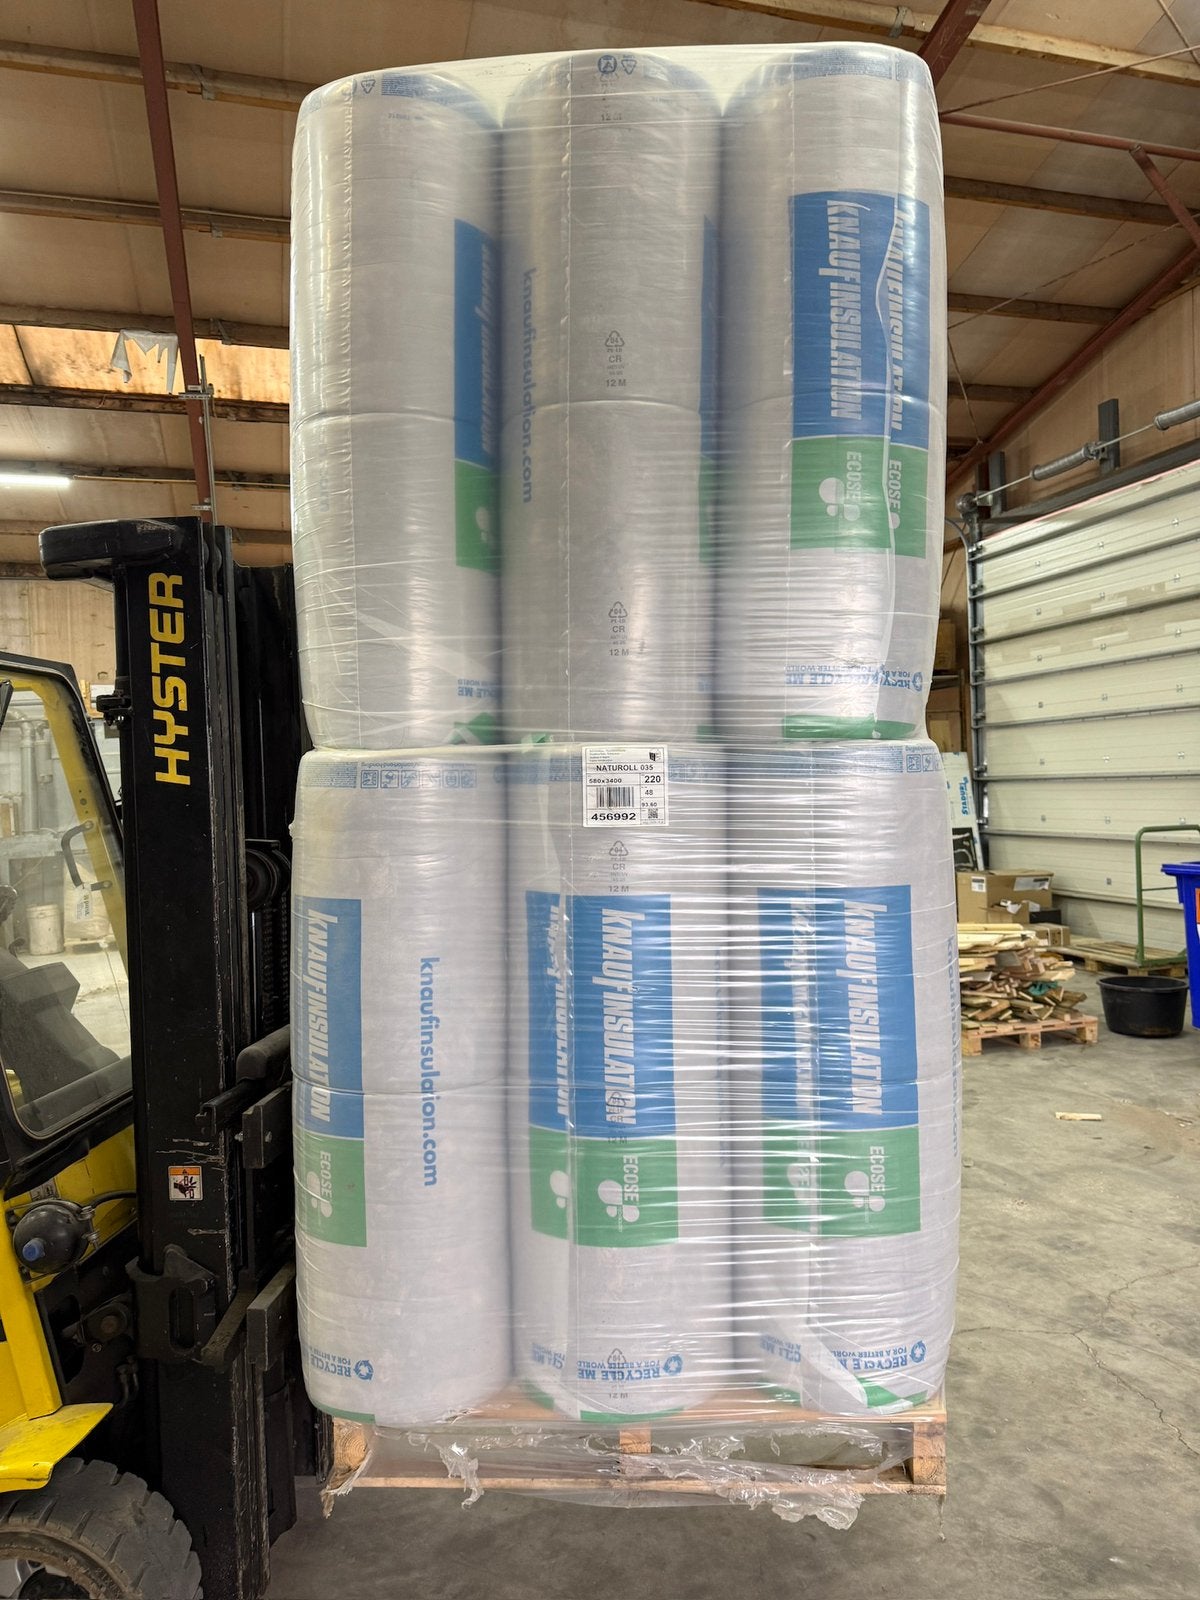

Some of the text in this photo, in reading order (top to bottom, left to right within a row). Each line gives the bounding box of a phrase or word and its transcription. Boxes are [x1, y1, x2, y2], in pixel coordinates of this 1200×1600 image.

[608, 355, 622, 363] CR
[606, 379, 627, 388] 12 M
[889, 459, 902, 511] ECOSE
[612, 625, 625, 633] CR
[609, 649, 620, 657] 12
[149, 572, 191, 786] HYSTER
[596, 764, 638, 772] NATUROLL
[644, 775, 661, 784] 220
[590, 812, 637, 821] 456992
[612, 863, 626, 871] CR
[608, 885, 630, 893] 12 M
[836, 900, 887, 1116] KNAUFINSULATION
[302, 909, 338, 1122] KNAUFINSULATON
[592, 908, 645, 1125] KNAUFINSULATION
[319, 1150, 332, 1197] ECOSE
[870, 1146, 885, 1192] ECOSE
[623, 1154, 639, 1202] ECOSE
[858, 1350, 884, 1358] BETTER
[884, 1349, 891, 1357] A
[893, 1347, 907, 1355] FOR
[310, 1353, 352, 1378] RECYCLE
[577, 1360, 606, 1369] WORLD
[853, 1354, 908, 1371] RECYCLE
[577, 1368, 661, 1381] RECYCLE ME
